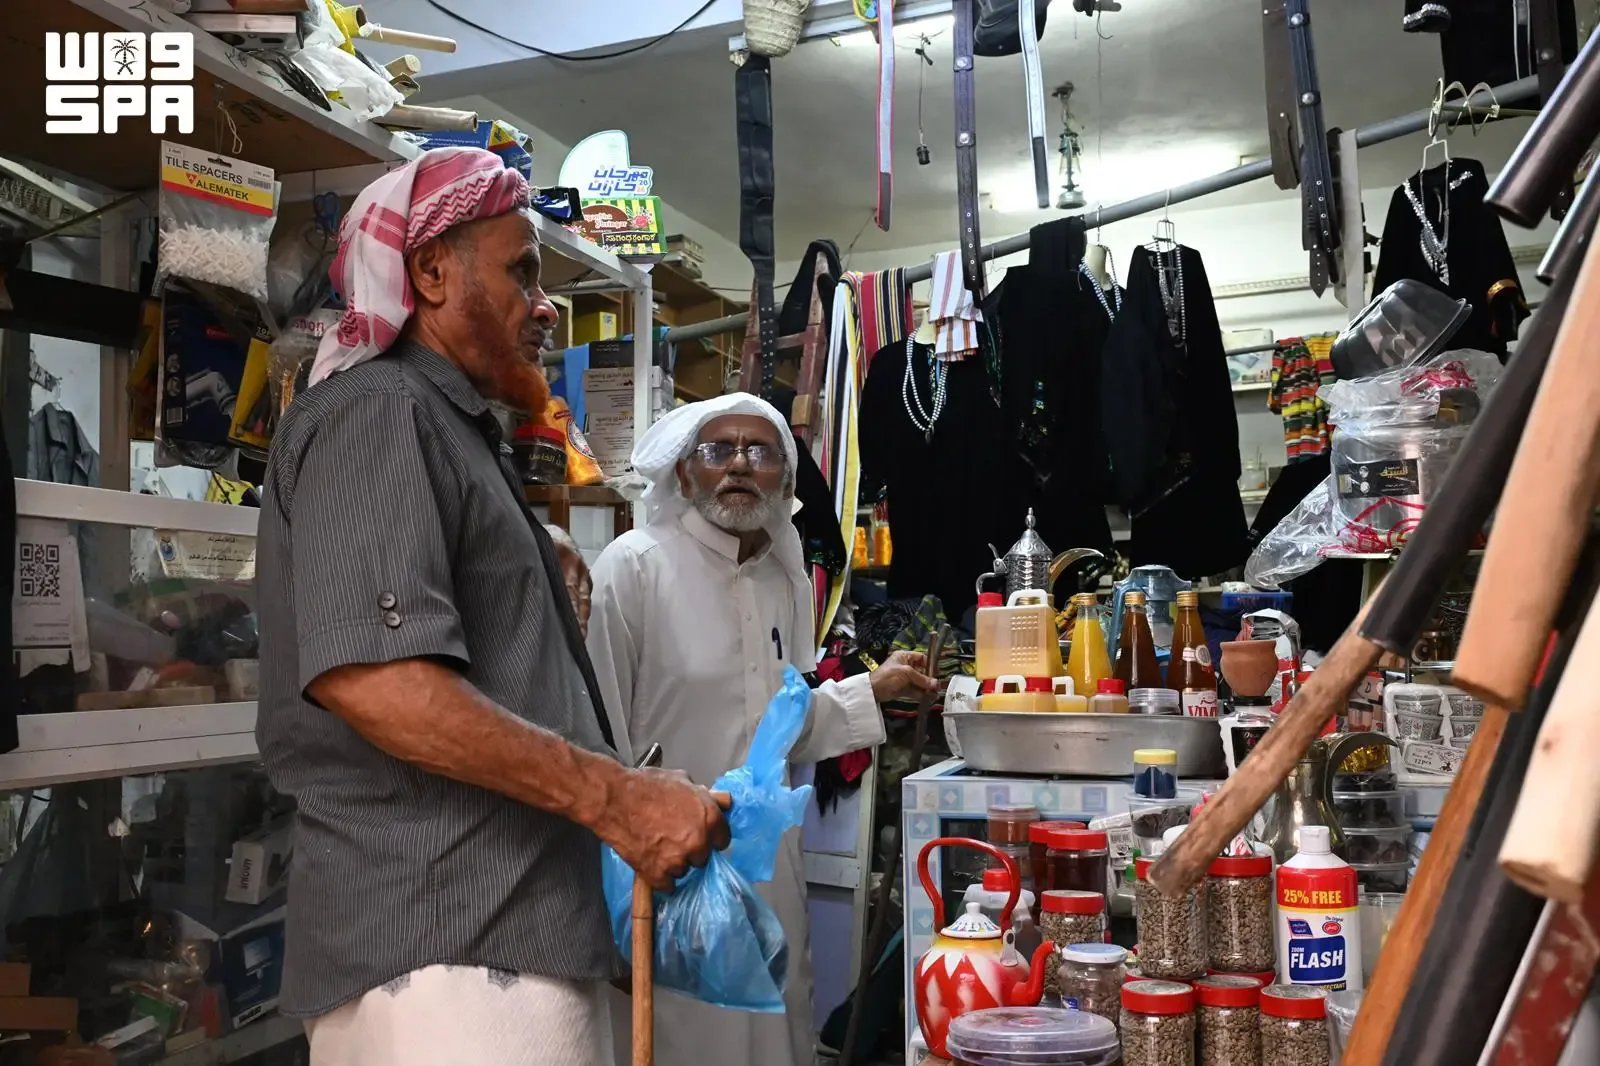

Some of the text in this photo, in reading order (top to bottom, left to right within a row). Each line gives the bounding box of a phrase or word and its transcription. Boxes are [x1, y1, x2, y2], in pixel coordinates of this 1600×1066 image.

[165, 156, 243, 184] TILE SPACERS
[594, 166, 649, 182] مهرجان
[196, 180, 249, 200] ALEMATEK
[588, 179, 637, 196] جازان
[1283, 889, 1342, 905] 25% FREE
[1290, 949, 1344, 969] FLASH
